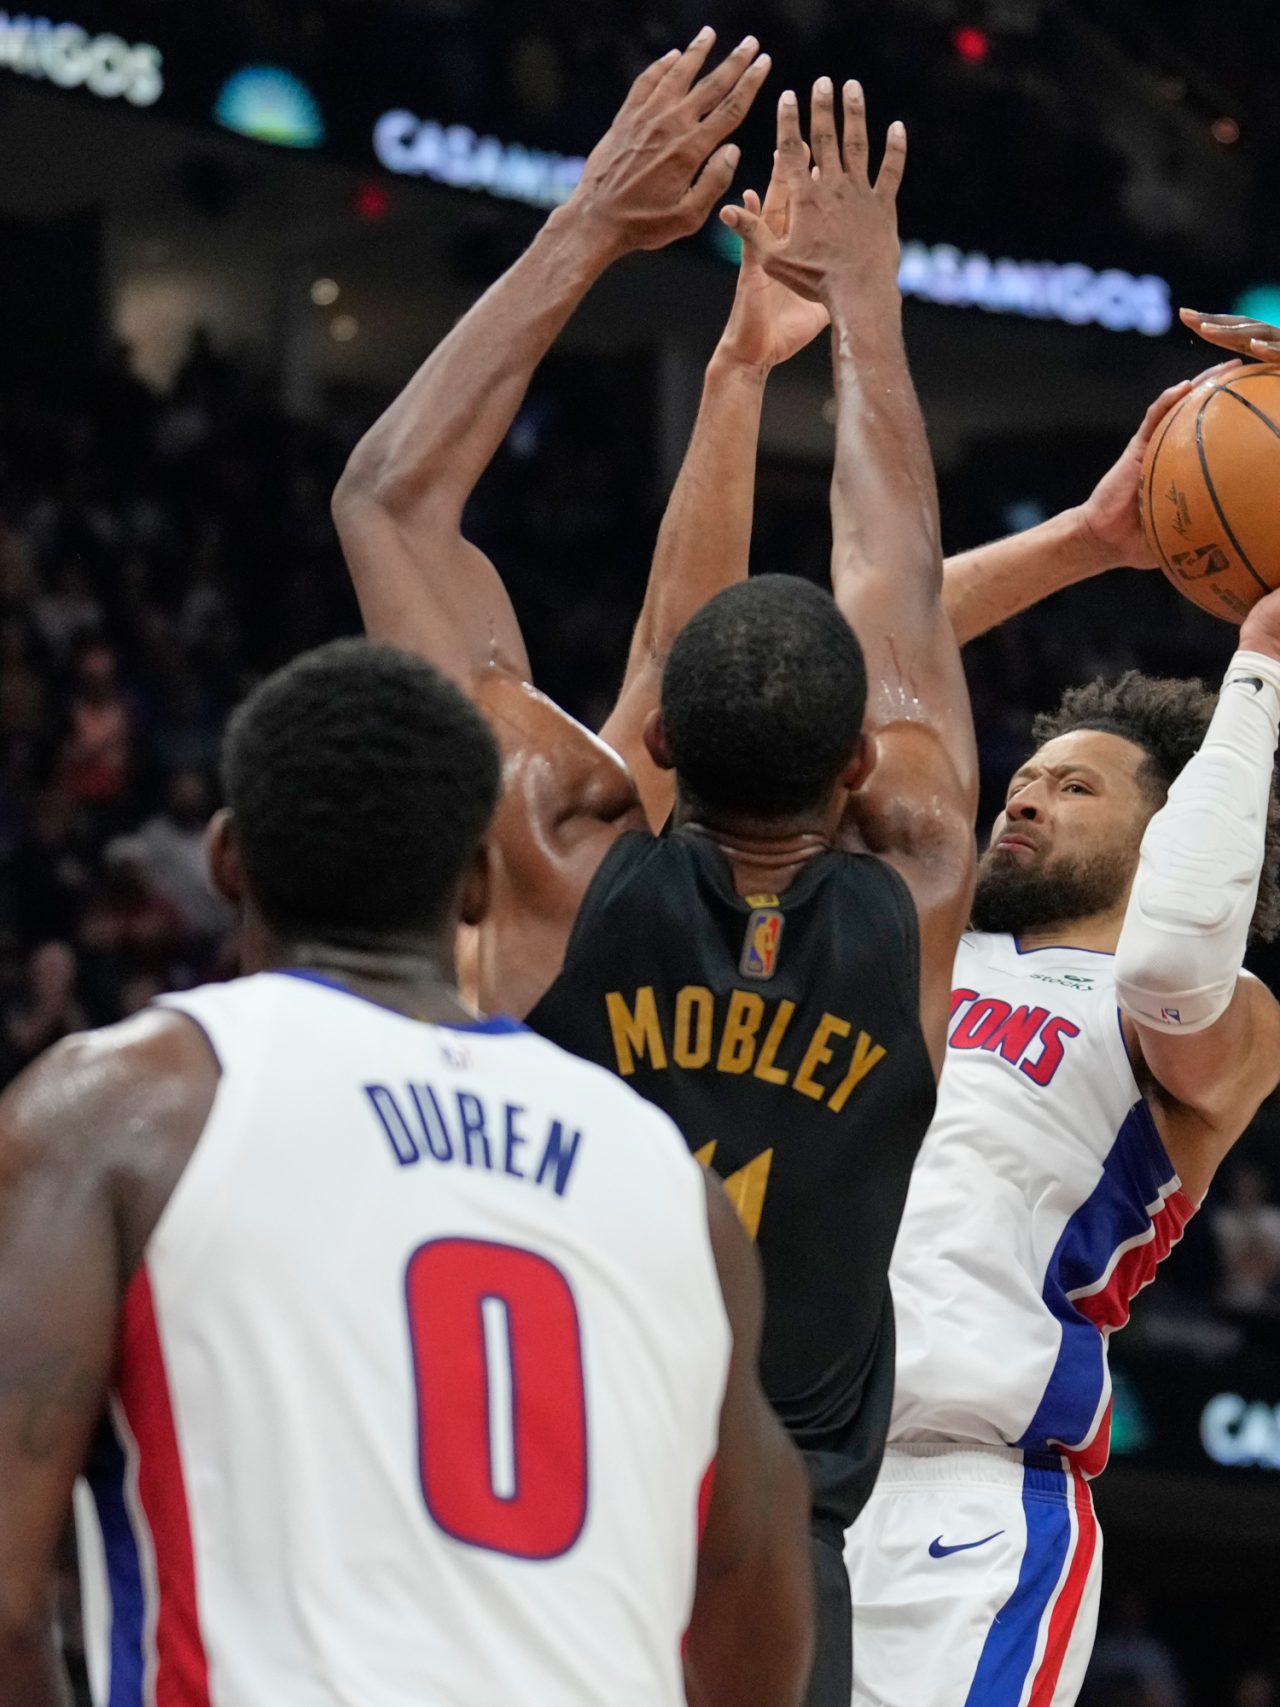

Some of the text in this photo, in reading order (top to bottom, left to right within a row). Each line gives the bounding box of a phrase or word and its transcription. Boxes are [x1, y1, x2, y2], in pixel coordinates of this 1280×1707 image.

[605, 985, 887, 1113] MOBLEY
[363, 1083, 582, 1196] DUREN
[404, 1236, 588, 1561] 0
